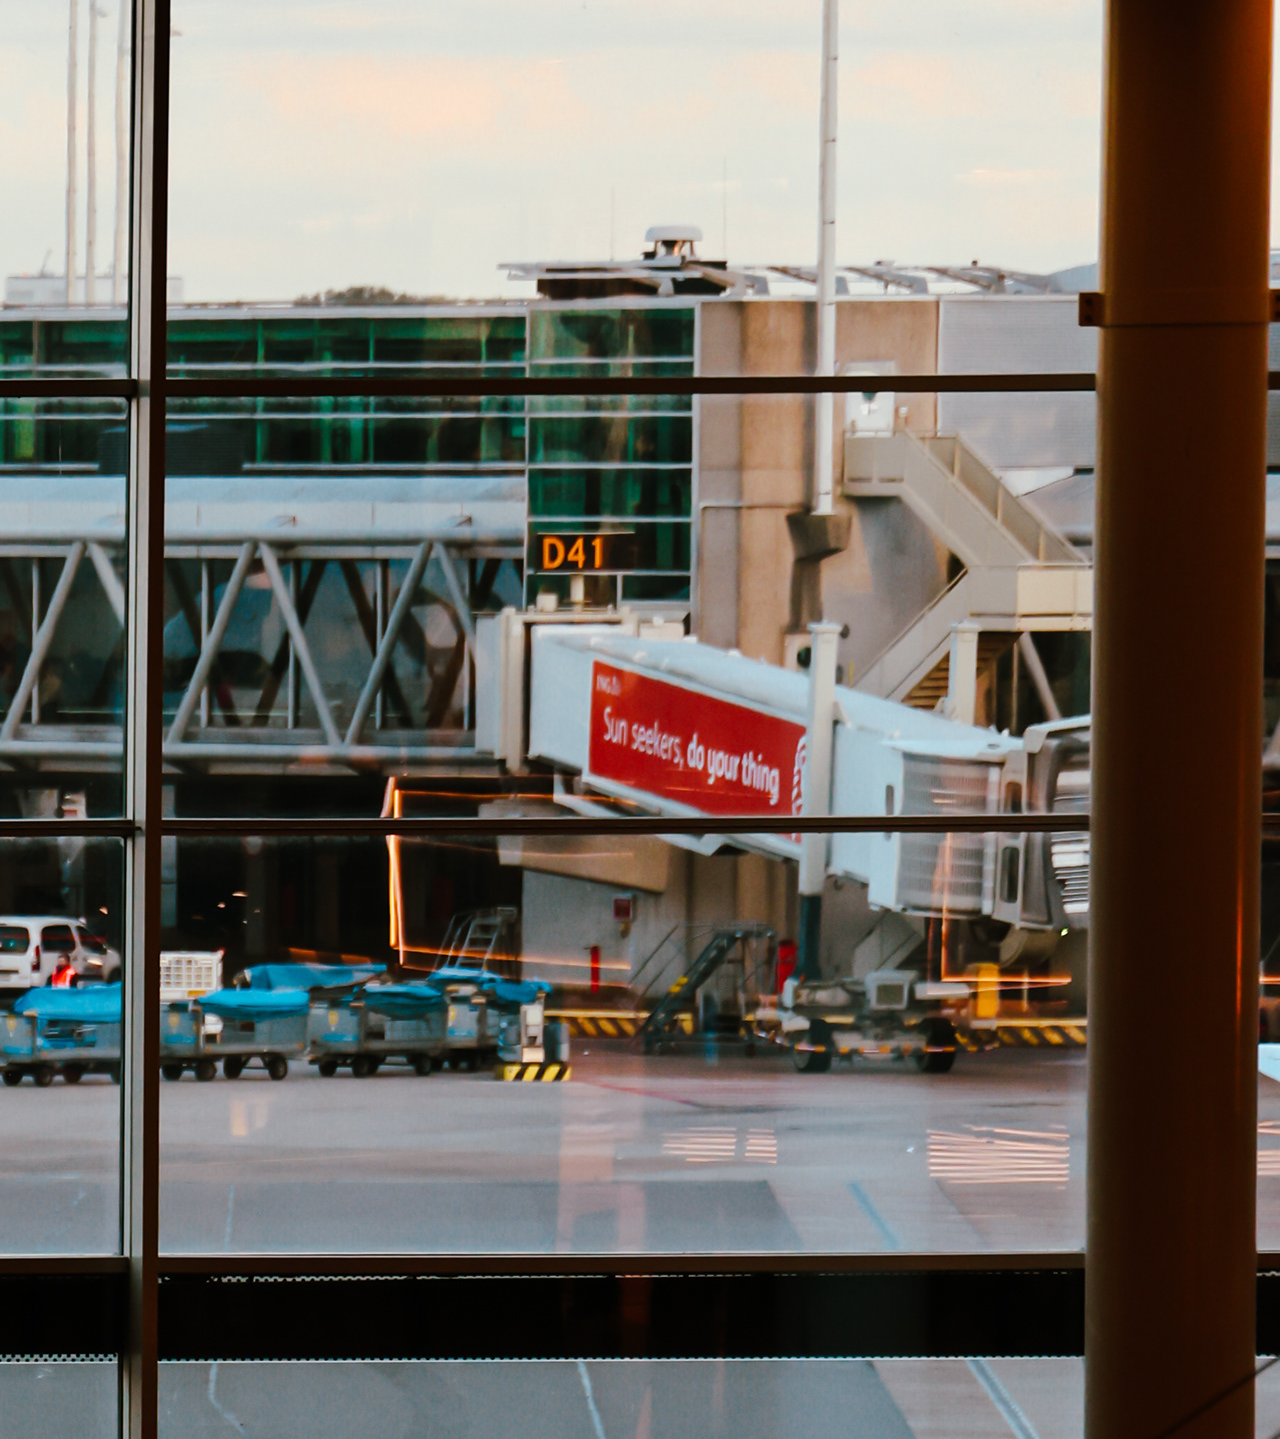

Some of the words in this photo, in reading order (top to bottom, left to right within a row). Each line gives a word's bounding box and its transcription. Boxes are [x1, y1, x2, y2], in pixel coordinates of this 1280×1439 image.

[542, 536, 604, 569] D41
[603, 706, 628, 746] Sun
[631, 720, 684, 771] seekers,
[687, 732, 705, 770] do
[707, 748, 740, 785] your
[742, 751, 780, 806] thing
